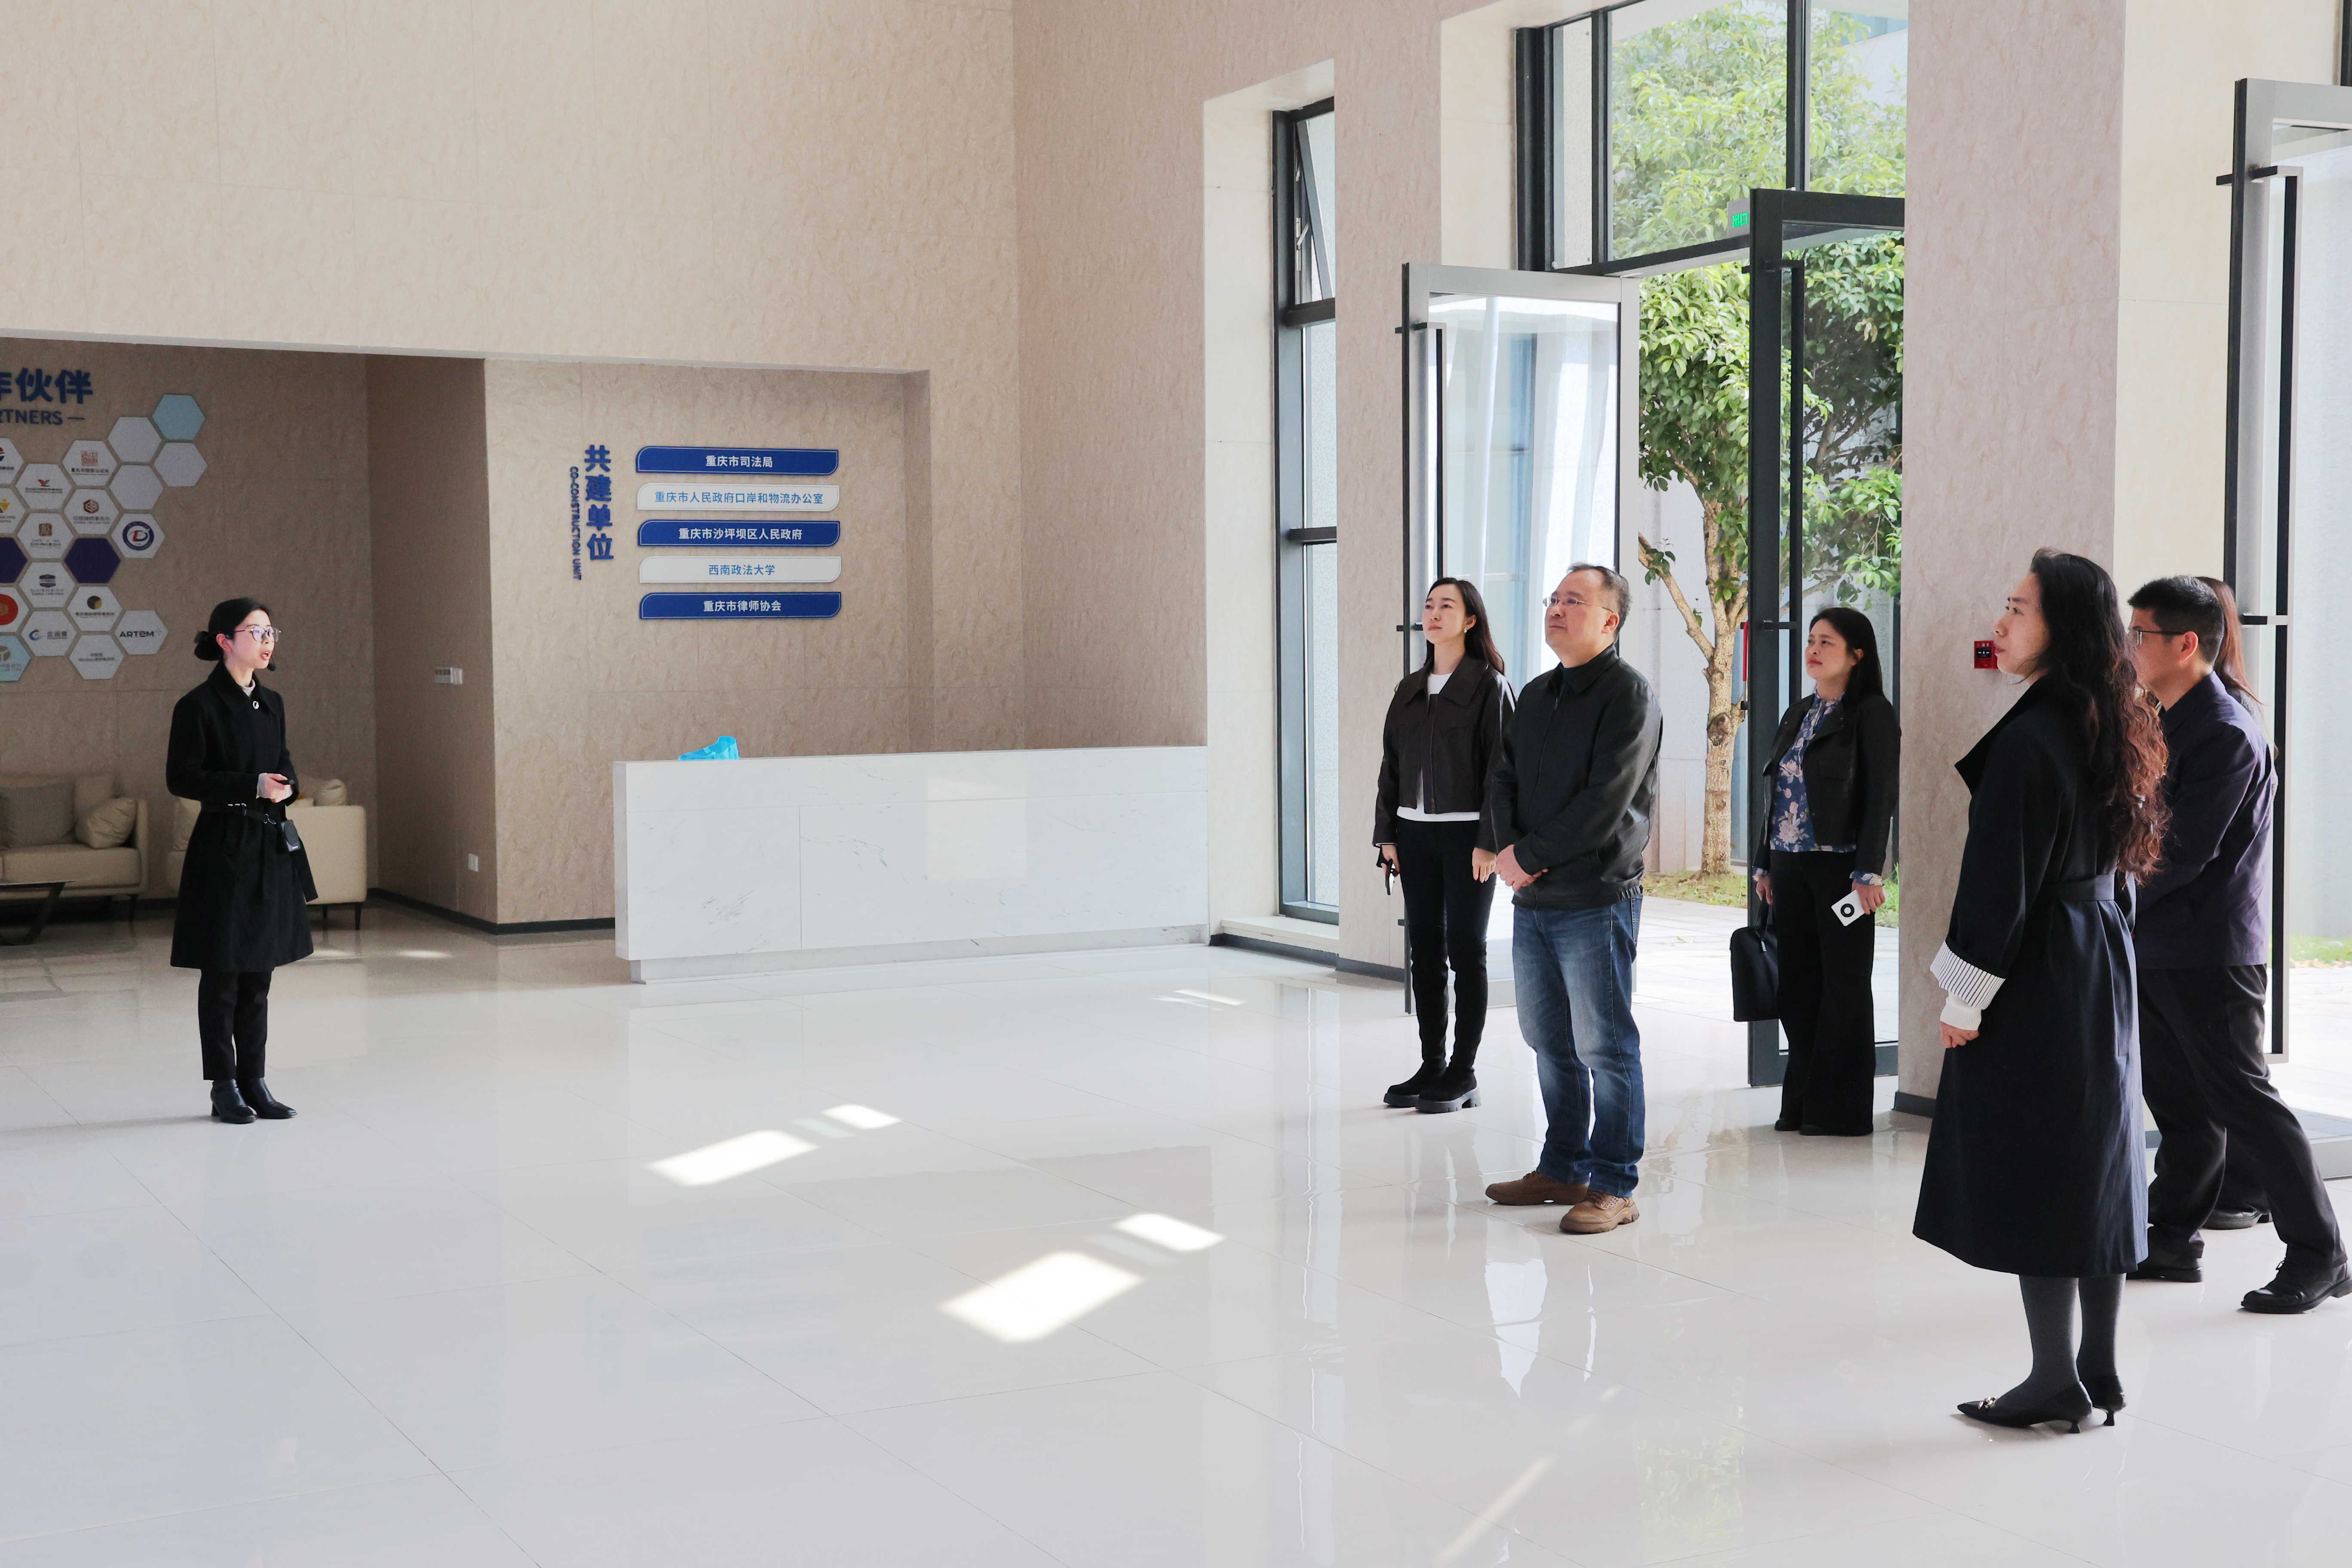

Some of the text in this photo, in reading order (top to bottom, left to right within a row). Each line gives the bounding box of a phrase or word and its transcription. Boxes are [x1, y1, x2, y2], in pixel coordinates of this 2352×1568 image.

[1732, 212, 1749, 227] 出口
[0, 409, 63, 425] TNERS
[705, 455, 773, 468] 重庆市司法局
[584, 445, 614, 560] 共建单位
[654, 491, 824, 505] 重庆市人民政府口岸和物流办公室
[570, 466, 582, 580] CO-CONSTRUCTION UNIT
[678, 528, 802, 540] 重庆市沙坪坝区人民政府
[708, 564, 775, 576] 西南政法大学
[703, 600, 782, 612] 重庆市律师协会
